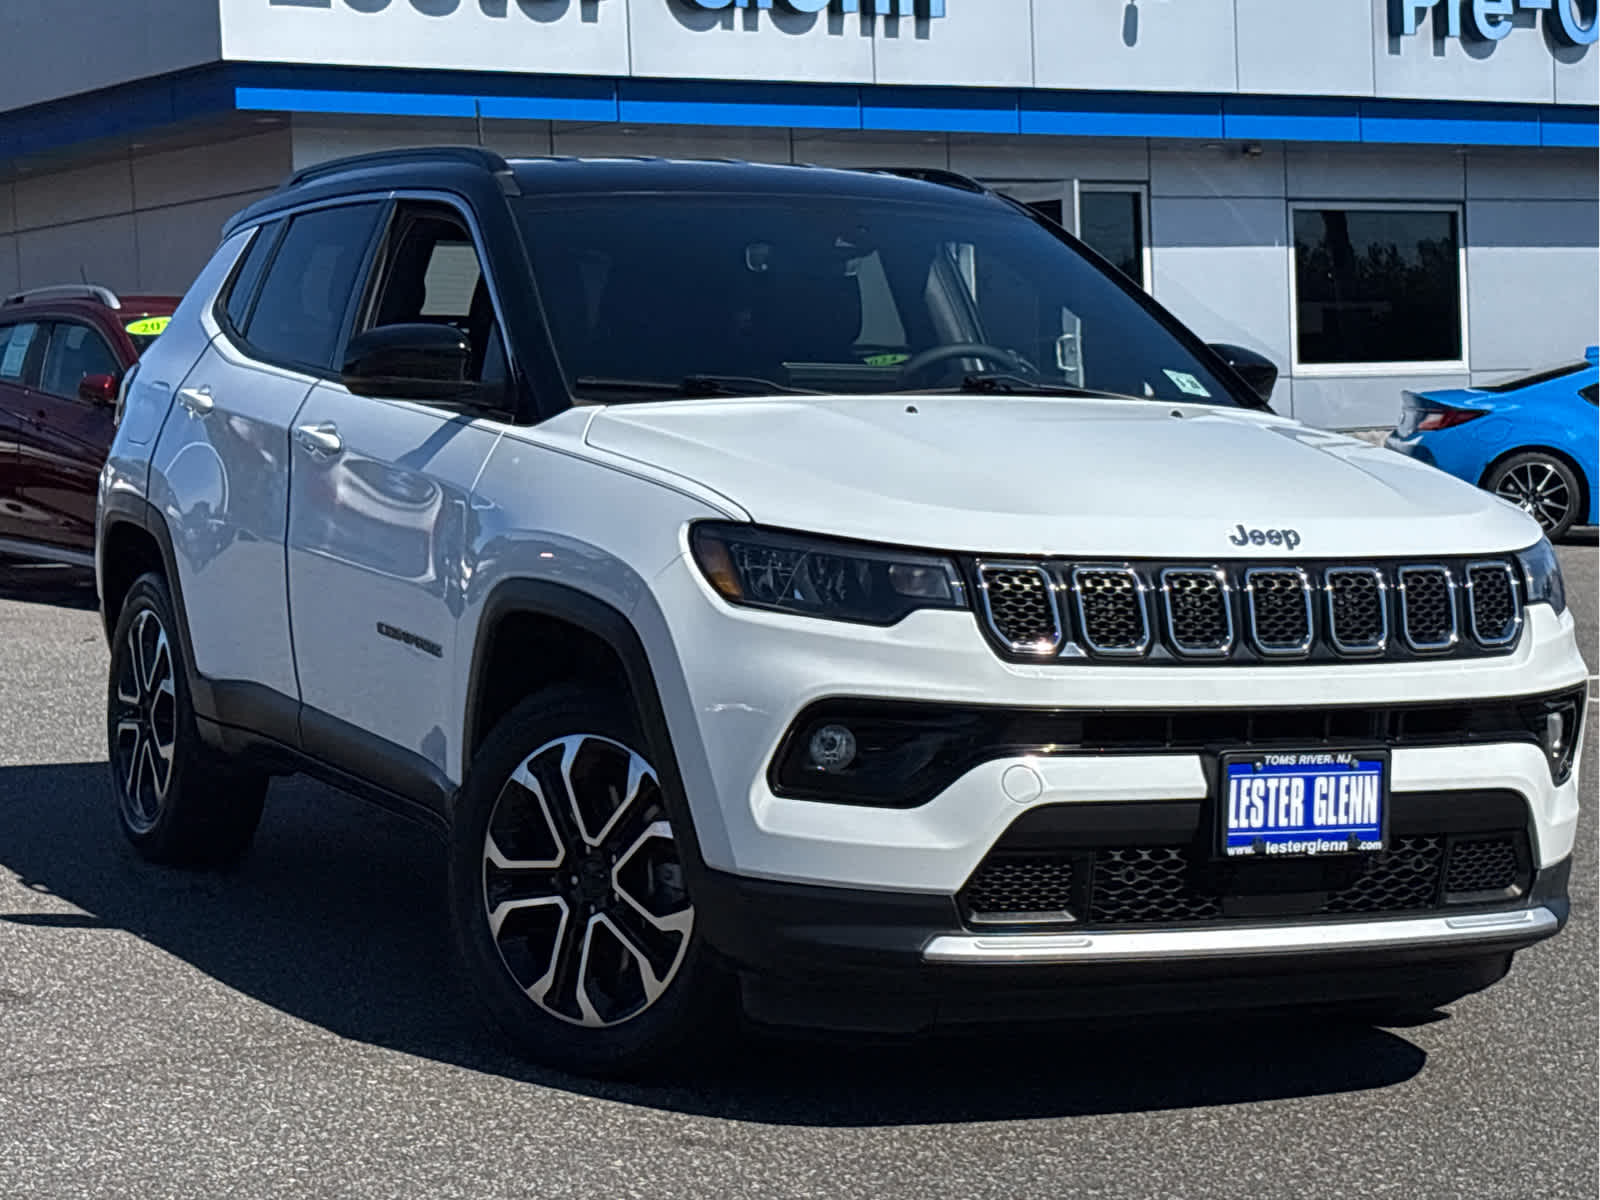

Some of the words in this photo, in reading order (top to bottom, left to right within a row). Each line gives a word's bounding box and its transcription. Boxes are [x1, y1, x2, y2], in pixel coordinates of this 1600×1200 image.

[1229, 524, 1300, 550] Jeep
[1265, 754, 1296, 765] TOMS
[1336, 753, 1351, 764] NJ
[1228, 777, 1305, 829] LESTER
[1313, 775, 1379, 826] GLENN
[1265, 838, 1348, 855] lesterglenn
